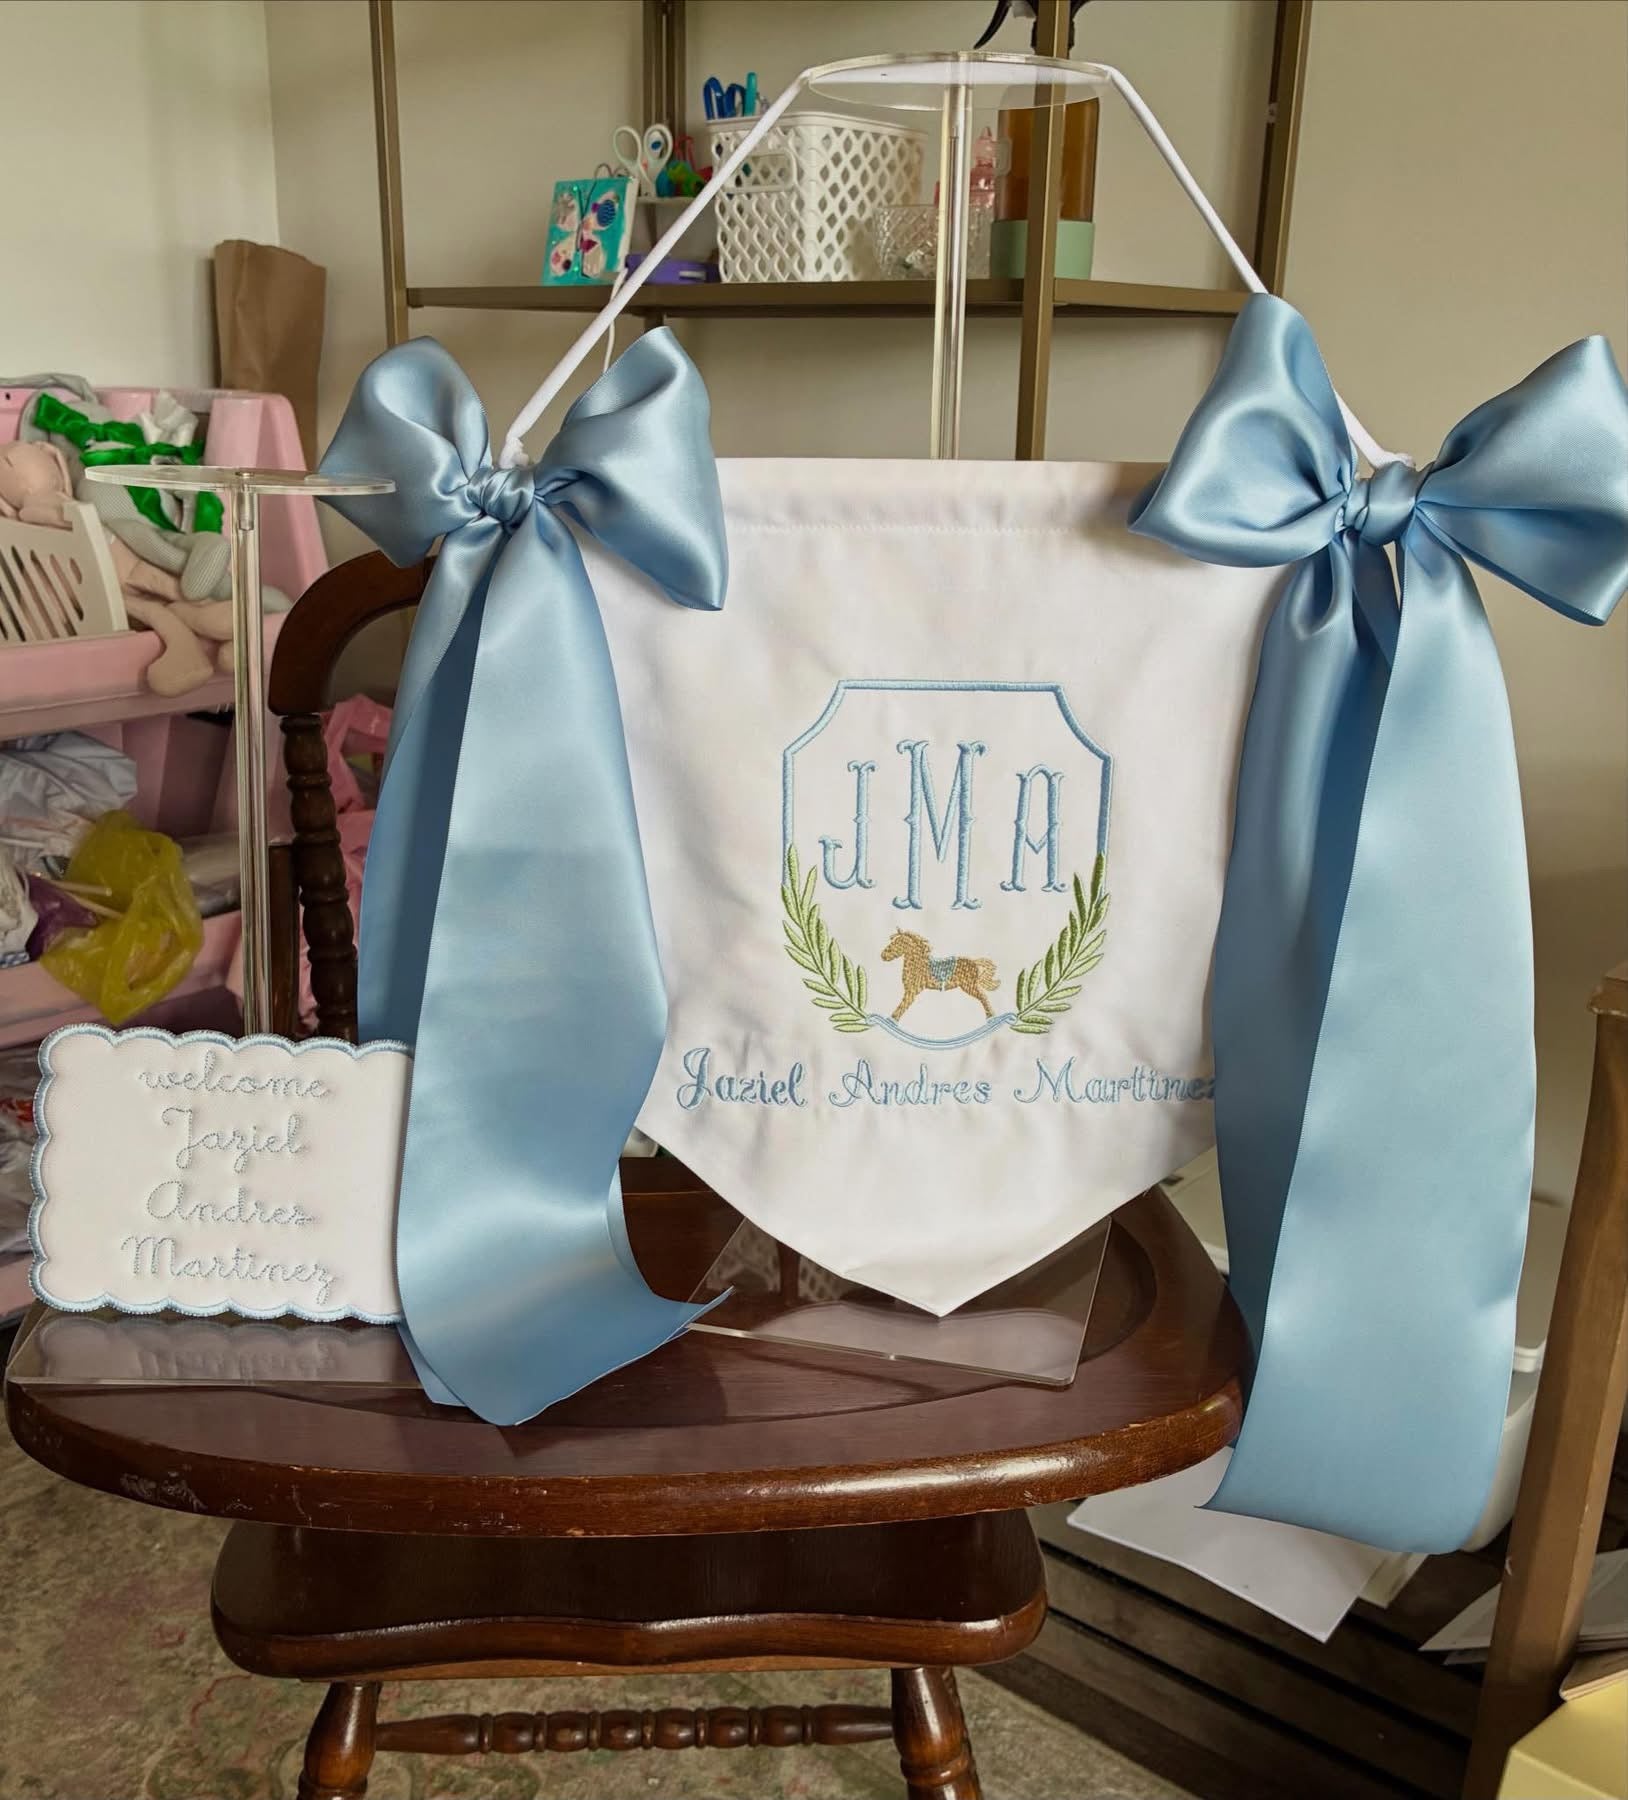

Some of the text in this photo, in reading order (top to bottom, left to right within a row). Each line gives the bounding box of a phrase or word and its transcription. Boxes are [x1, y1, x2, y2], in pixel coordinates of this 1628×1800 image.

[138, 1050, 330, 1098] welcome
[676, 1047, 807, 1109] Jaziel
[829, 1058, 991, 1107] Andres
[161, 1107, 309, 1173] Jaziel
[147, 1180, 315, 1226] Andres
[120, 1235, 335, 1305] Martinez
